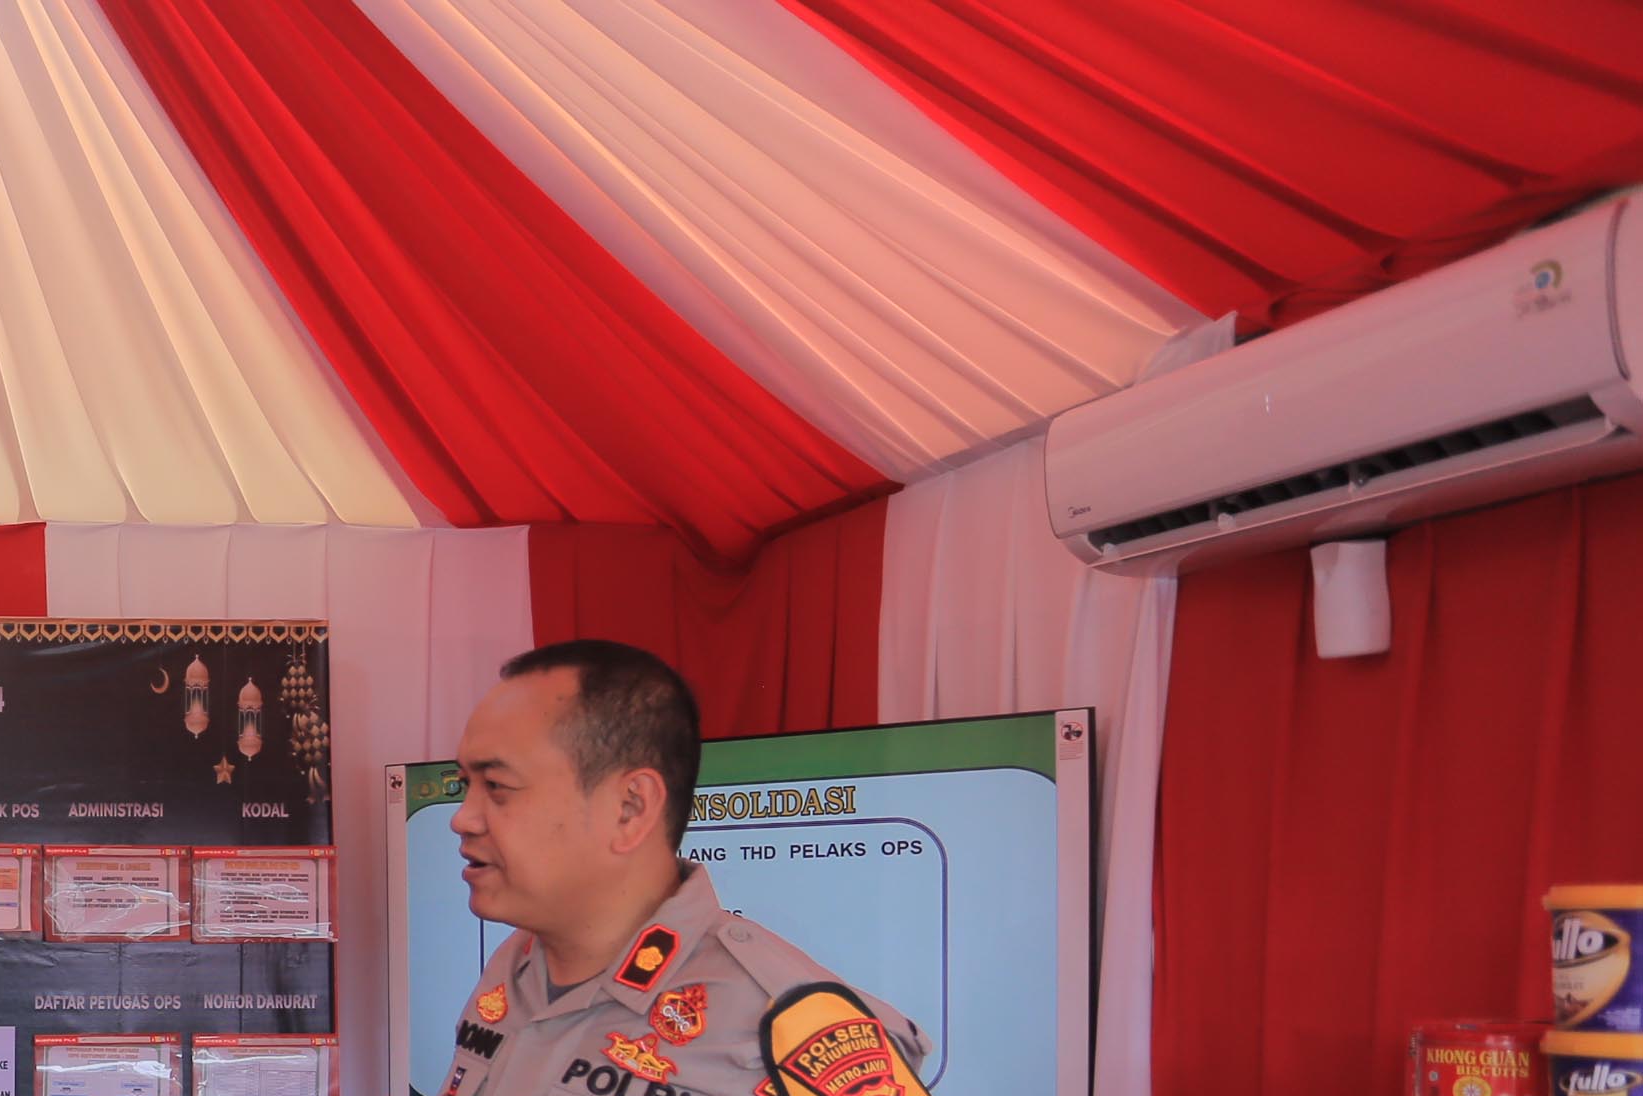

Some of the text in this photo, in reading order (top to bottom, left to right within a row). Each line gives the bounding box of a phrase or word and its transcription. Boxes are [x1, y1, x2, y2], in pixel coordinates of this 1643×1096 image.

[12, 803, 40, 818] POS
[68, 803, 164, 818] ADMINISTRASI
[242, 803, 289, 818] KODAL
[689, 786, 856, 822] NSOLIDASI
[678, 840, 923, 862] LANG THD PELAKS OPS
[1553, 918, 1605, 960] ullo
[35, 995, 182, 1010] DAFTAR PETUGAS OPS
[204, 995, 317, 1009] NOMOR DARURAT
[797, 1024, 876, 1069] POLSEK
[1426, 1047, 1529, 1067] KHONG GUAN
[808, 1037, 880, 1078] JATIUWUNG
[826, 1059, 887, 1095] METRO JAYA
[1456, 1066, 1529, 1078] BISCUITS
[1569, 1064, 1626, 1093] fullo
